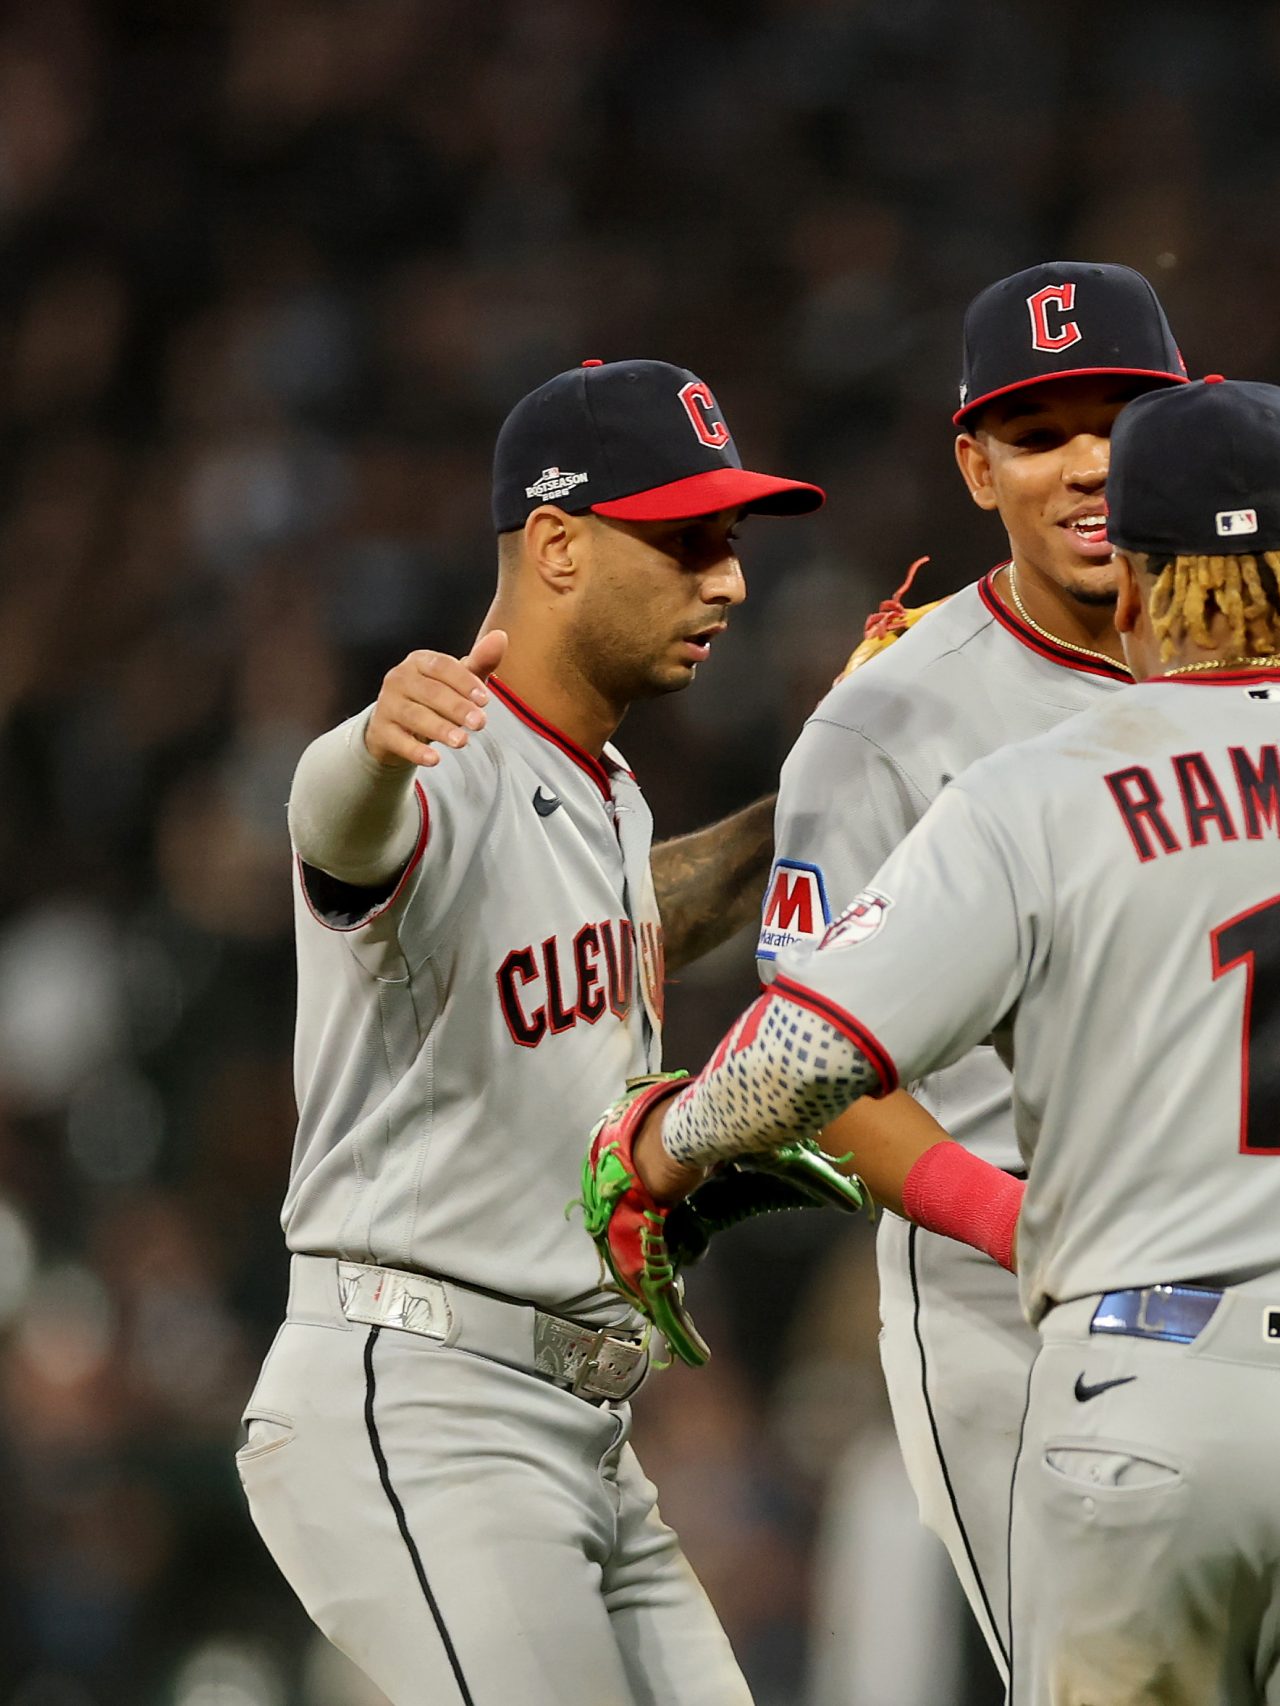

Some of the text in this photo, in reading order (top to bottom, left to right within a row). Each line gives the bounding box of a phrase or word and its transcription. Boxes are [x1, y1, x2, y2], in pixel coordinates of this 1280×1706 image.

[1026, 282, 1082, 353] C
[677, 381, 729, 449] C
[525, 472, 588, 498] POSTSEASON
[764, 873, 813, 934] M
